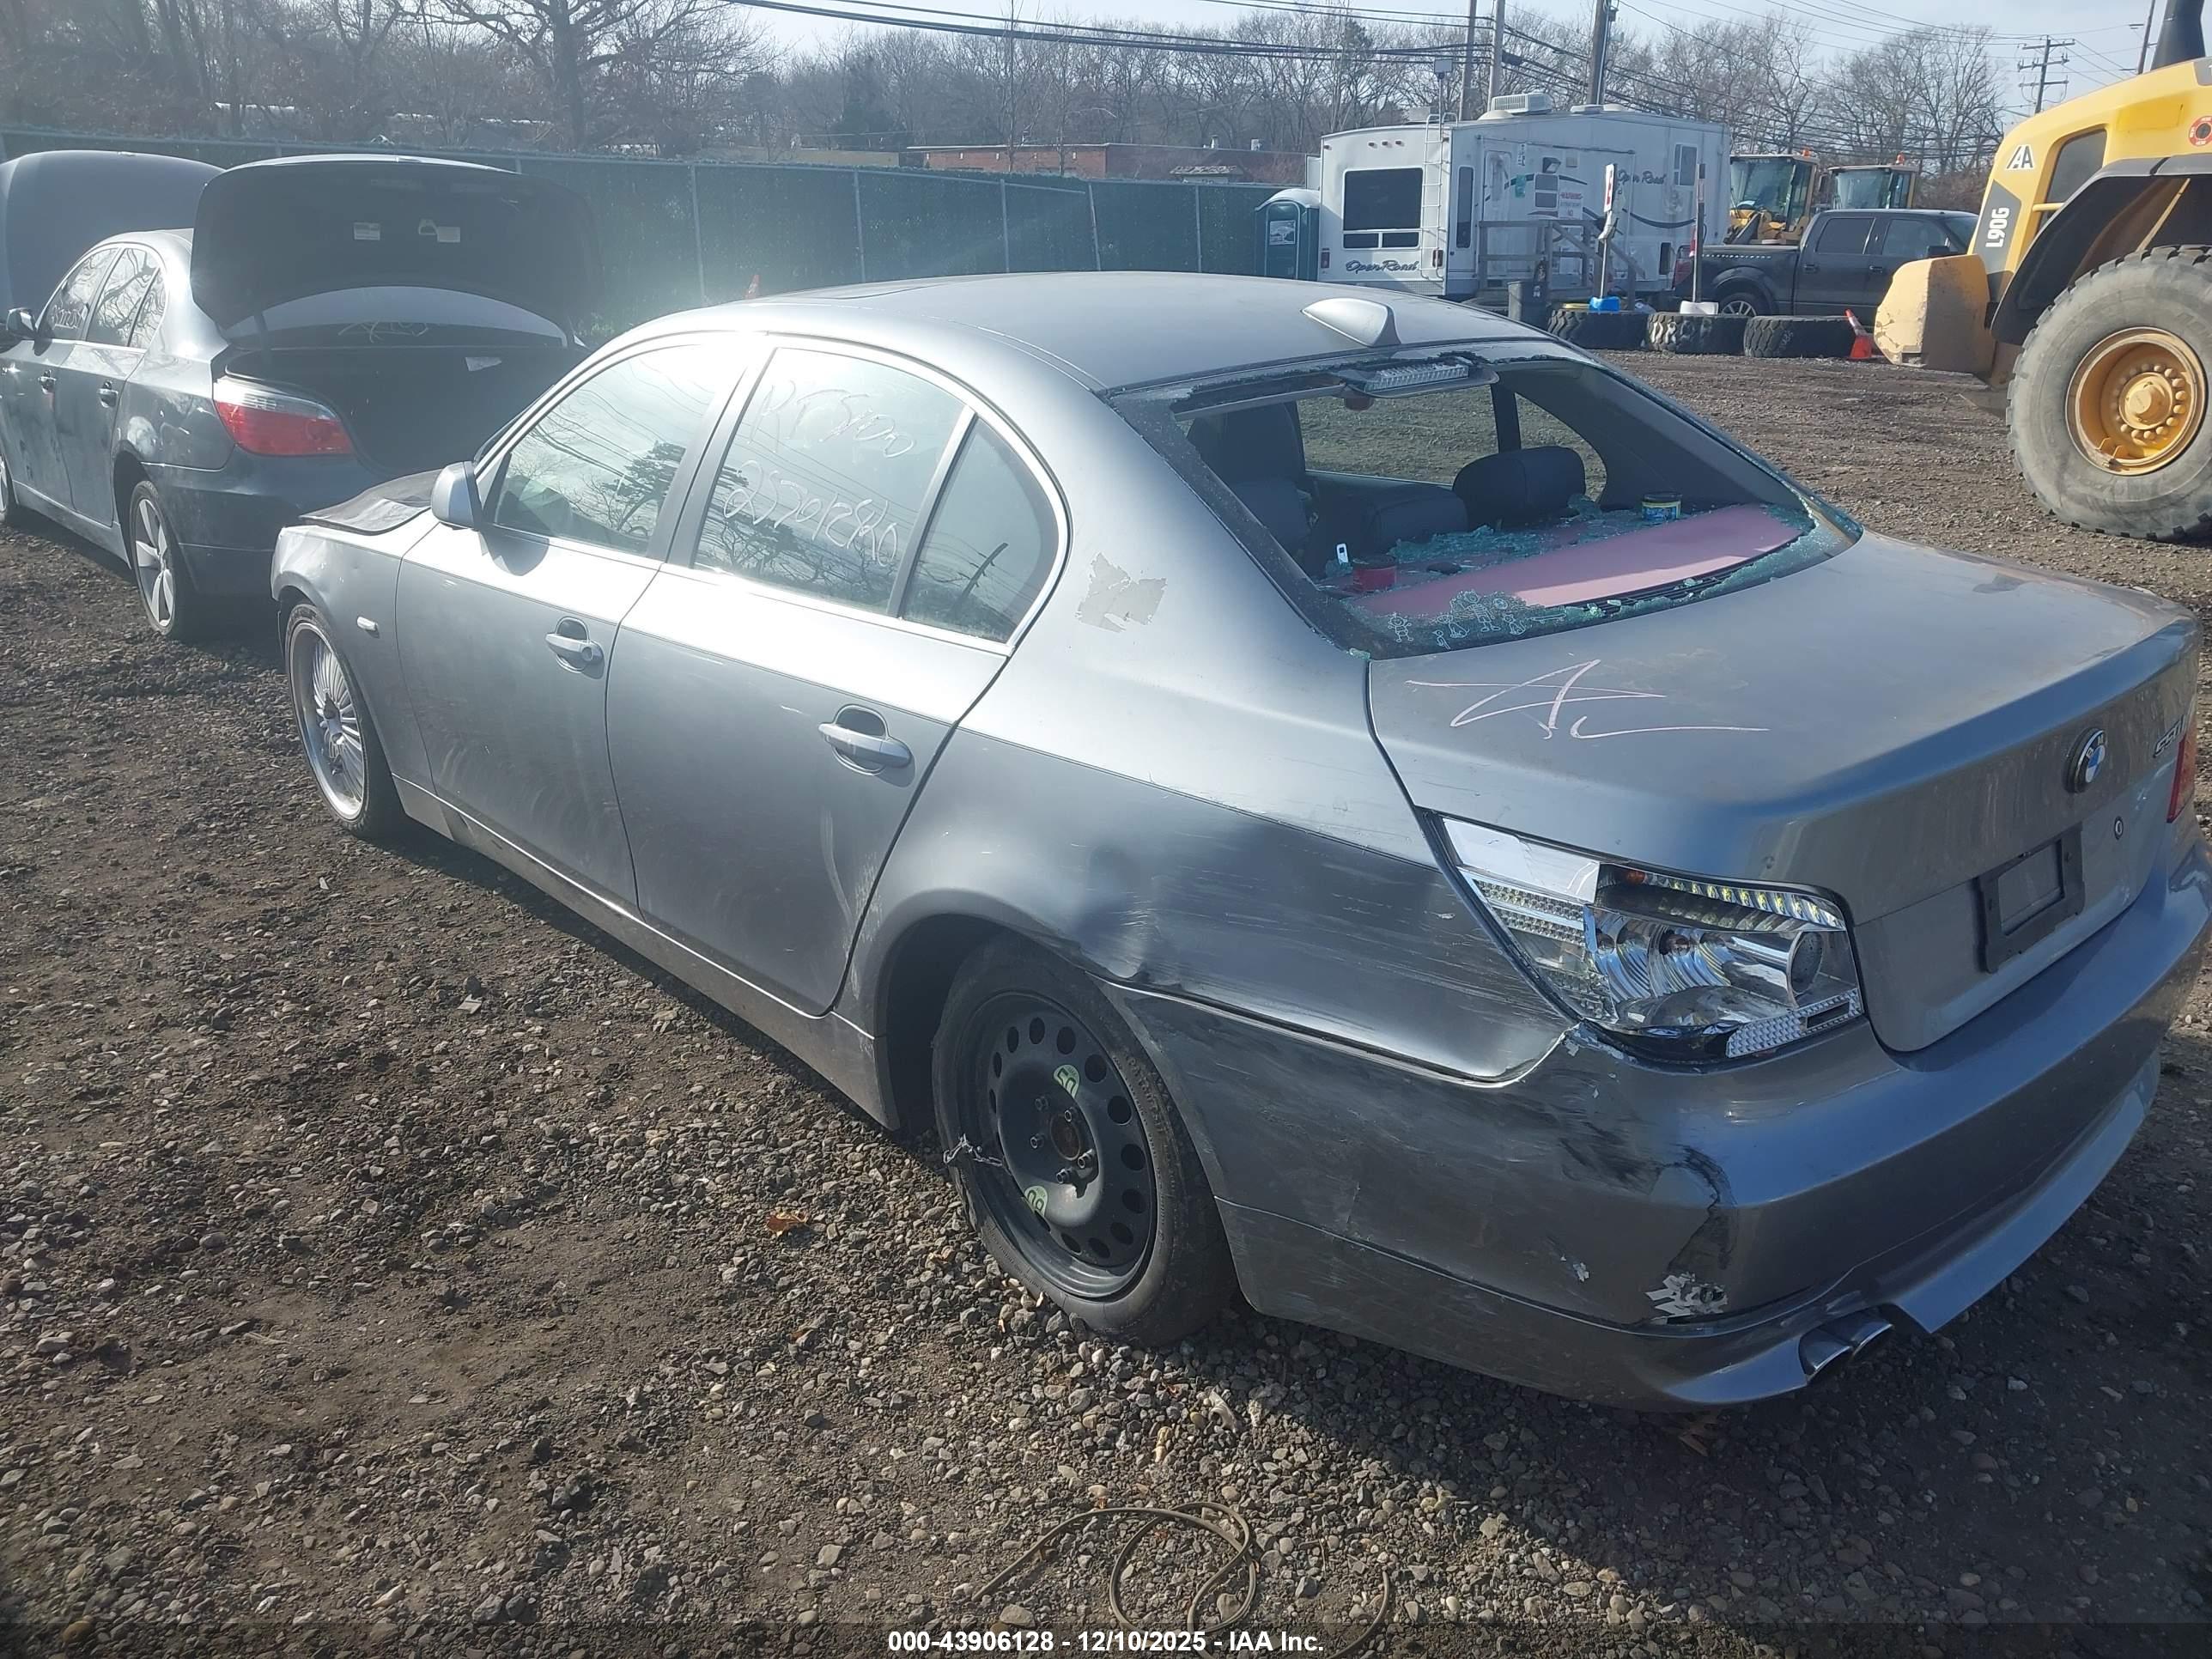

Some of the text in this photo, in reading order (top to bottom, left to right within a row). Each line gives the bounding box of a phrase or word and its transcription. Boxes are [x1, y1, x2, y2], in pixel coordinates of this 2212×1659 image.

[1642, 170, 1667, 185] Road
[1984, 207, 2010, 247] L90G
[1346, 259, 1419, 274] Open Road
